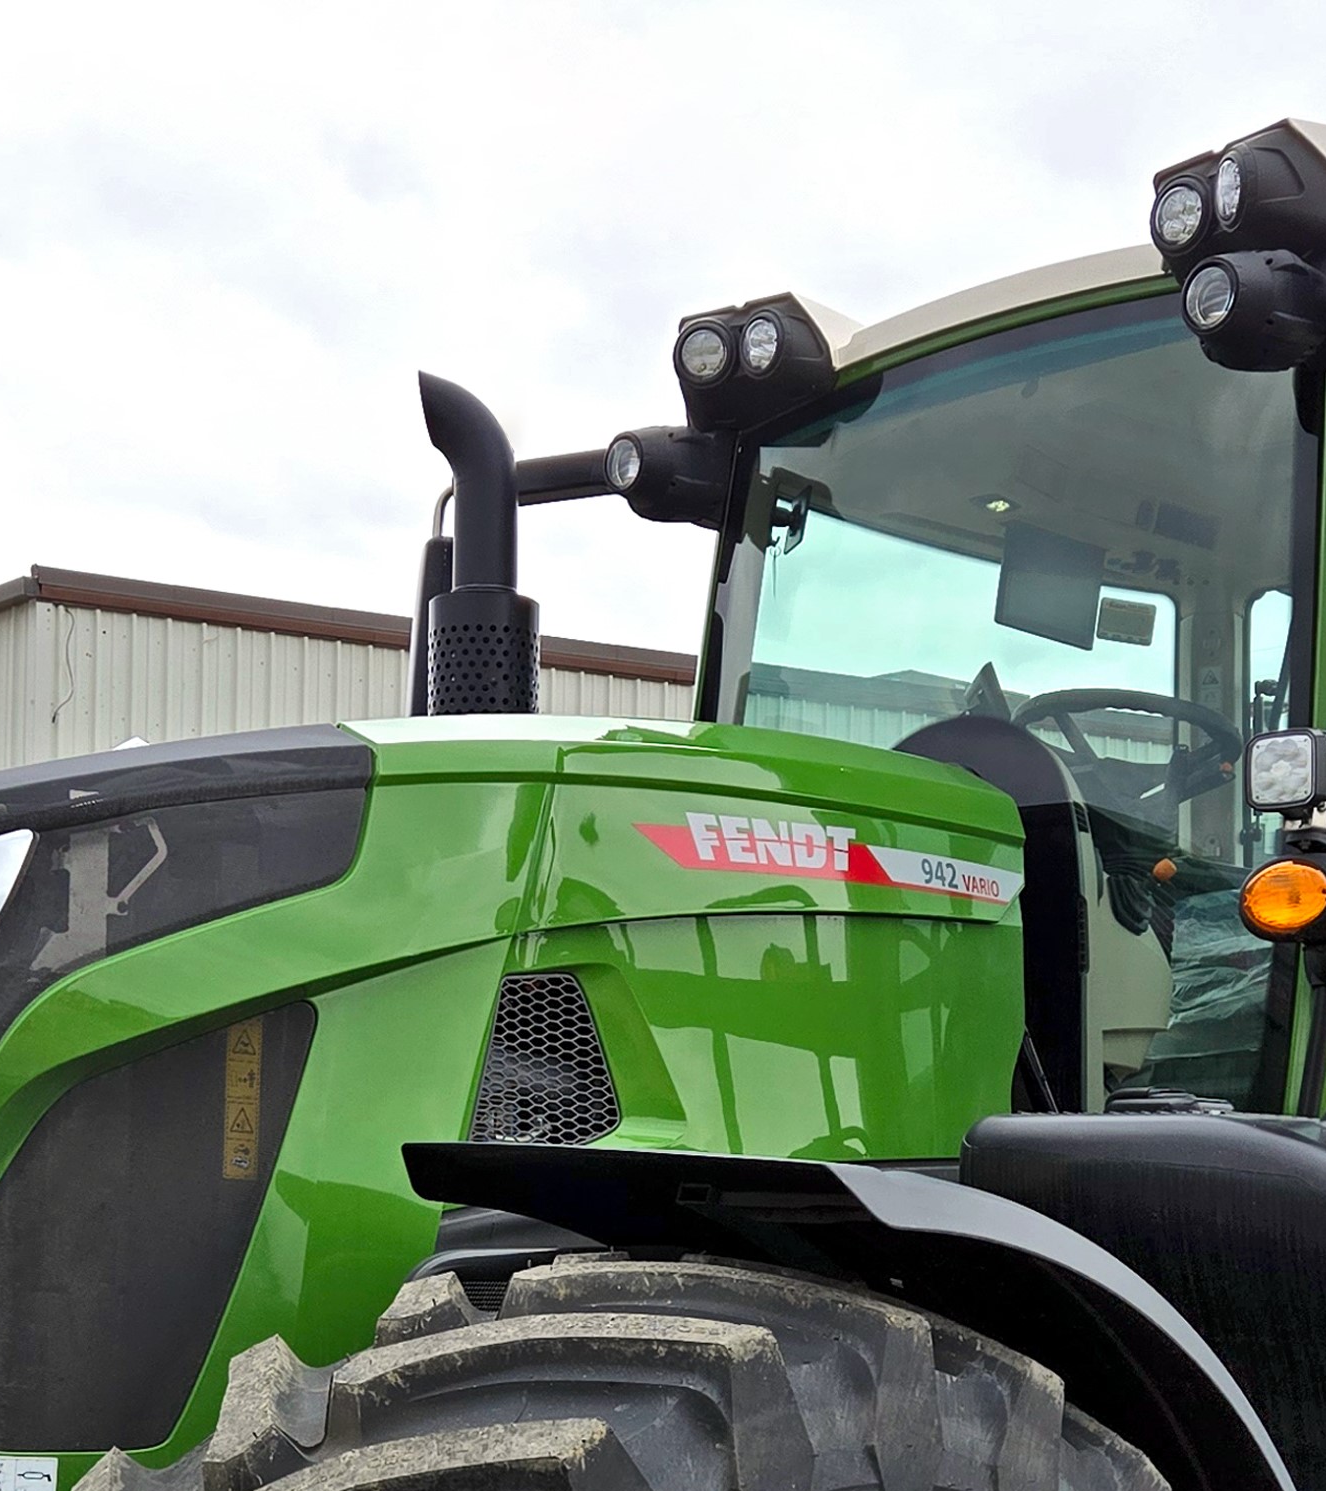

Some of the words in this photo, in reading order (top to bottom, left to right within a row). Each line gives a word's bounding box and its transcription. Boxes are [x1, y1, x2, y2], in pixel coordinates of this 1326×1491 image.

[685, 811, 857, 872] FENDT
[920, 857, 959, 890] 942
[962, 873, 1000, 898] VARIO
